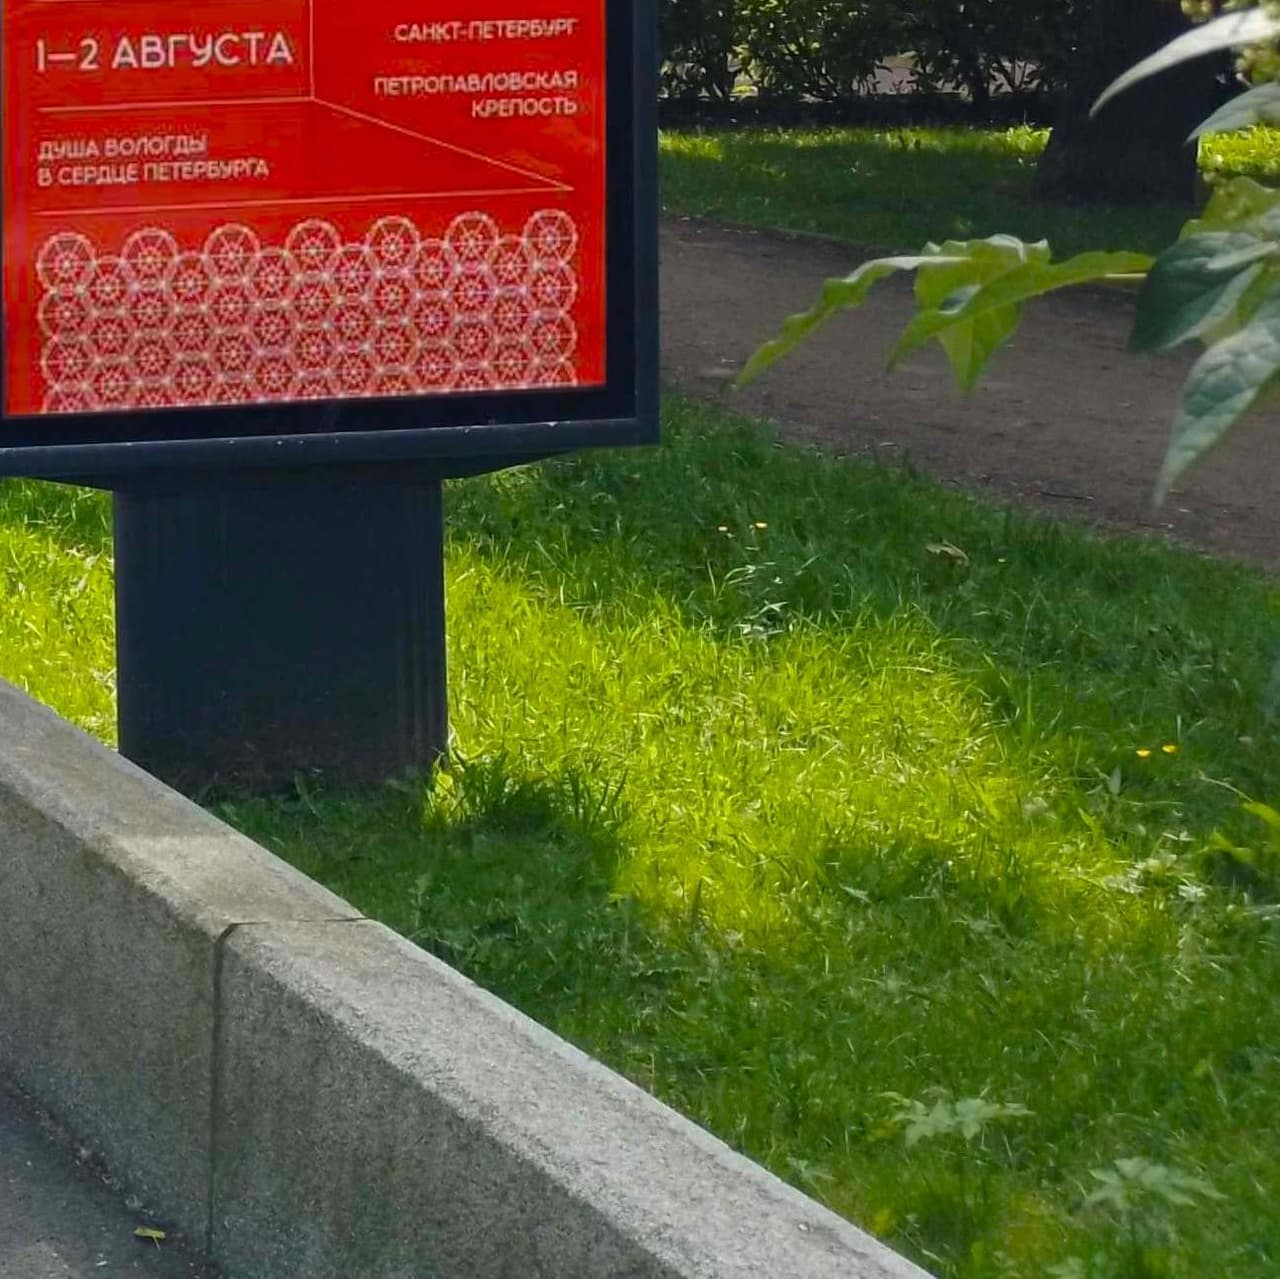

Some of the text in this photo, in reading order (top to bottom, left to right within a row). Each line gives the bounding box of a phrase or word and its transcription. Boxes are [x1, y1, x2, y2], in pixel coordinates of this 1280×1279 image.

[394, 18, 578, 41] САНКТ-ПЕТЕРБУРГ
[111, 32, 293, 69] АВГУСТА
[374, 71, 578, 95] ПЕТРОПАВЛОВСКАЯ
[472, 97, 577, 118] КРЕПОСТЬ
[38, 135, 207, 161] ДУША ВОЛОГДЫ
[38, 158, 270, 186] В СЕРДЦЕ ПЕТЕРБУРГА
